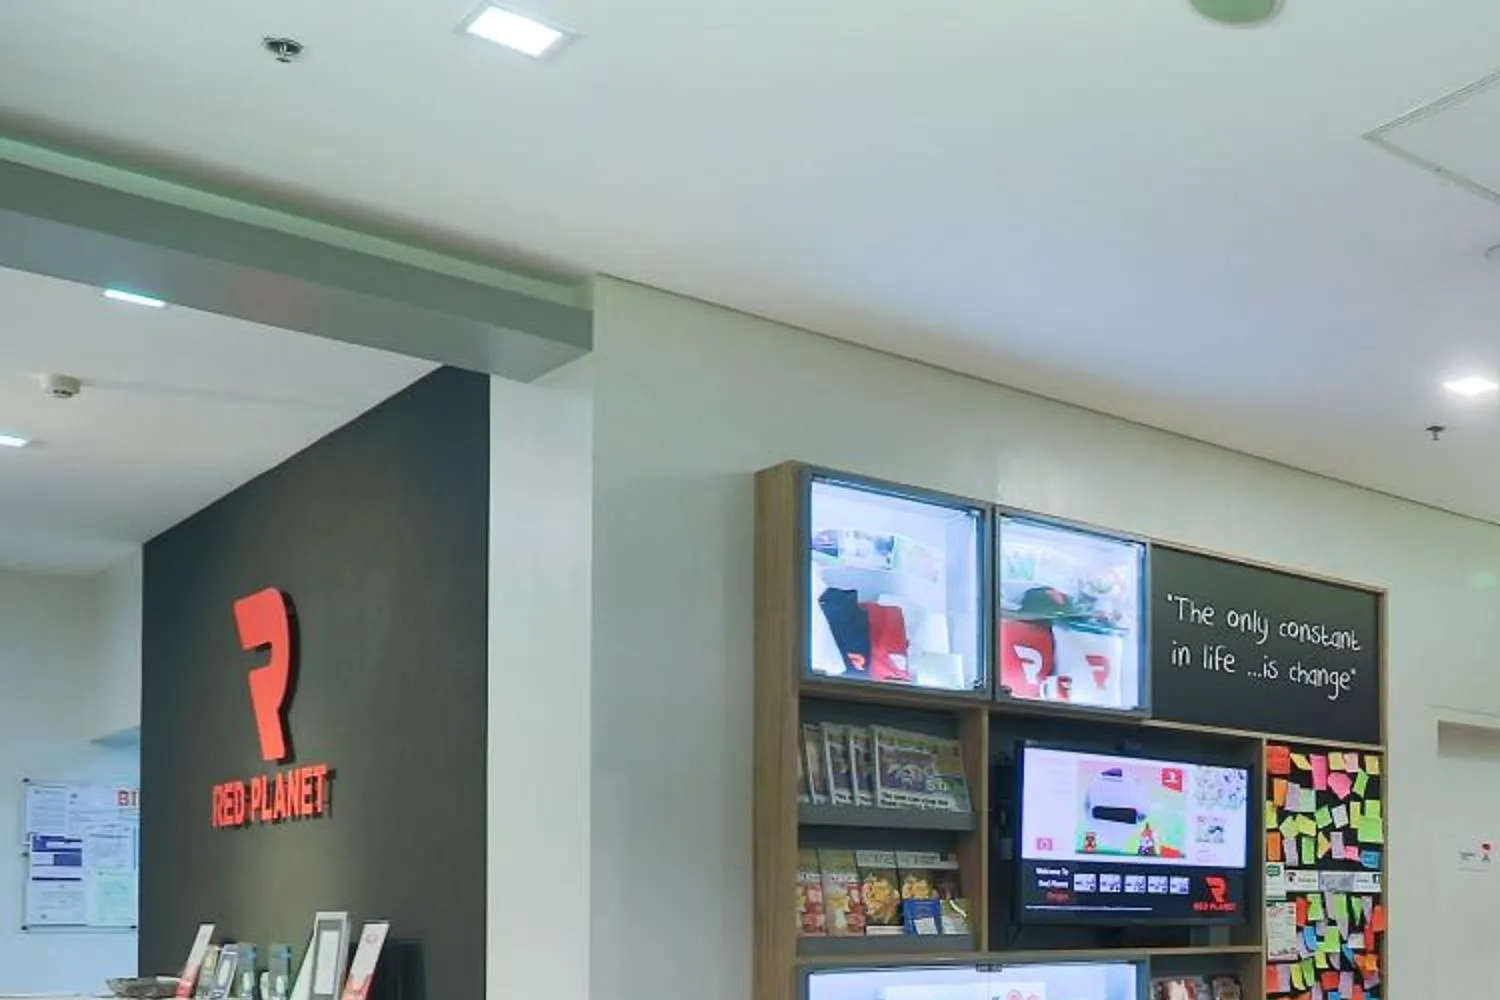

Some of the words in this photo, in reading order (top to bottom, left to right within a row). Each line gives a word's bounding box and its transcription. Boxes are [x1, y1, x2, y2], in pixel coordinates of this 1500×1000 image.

[1227, 609, 1269, 645] only
[1279, 621, 1361, 651] constant
[1171, 641, 1191, 667] in
[1203, 645, 1236, 672] life
[211, 780, 245, 828] RED
[250, 764, 328, 823] PLANET
